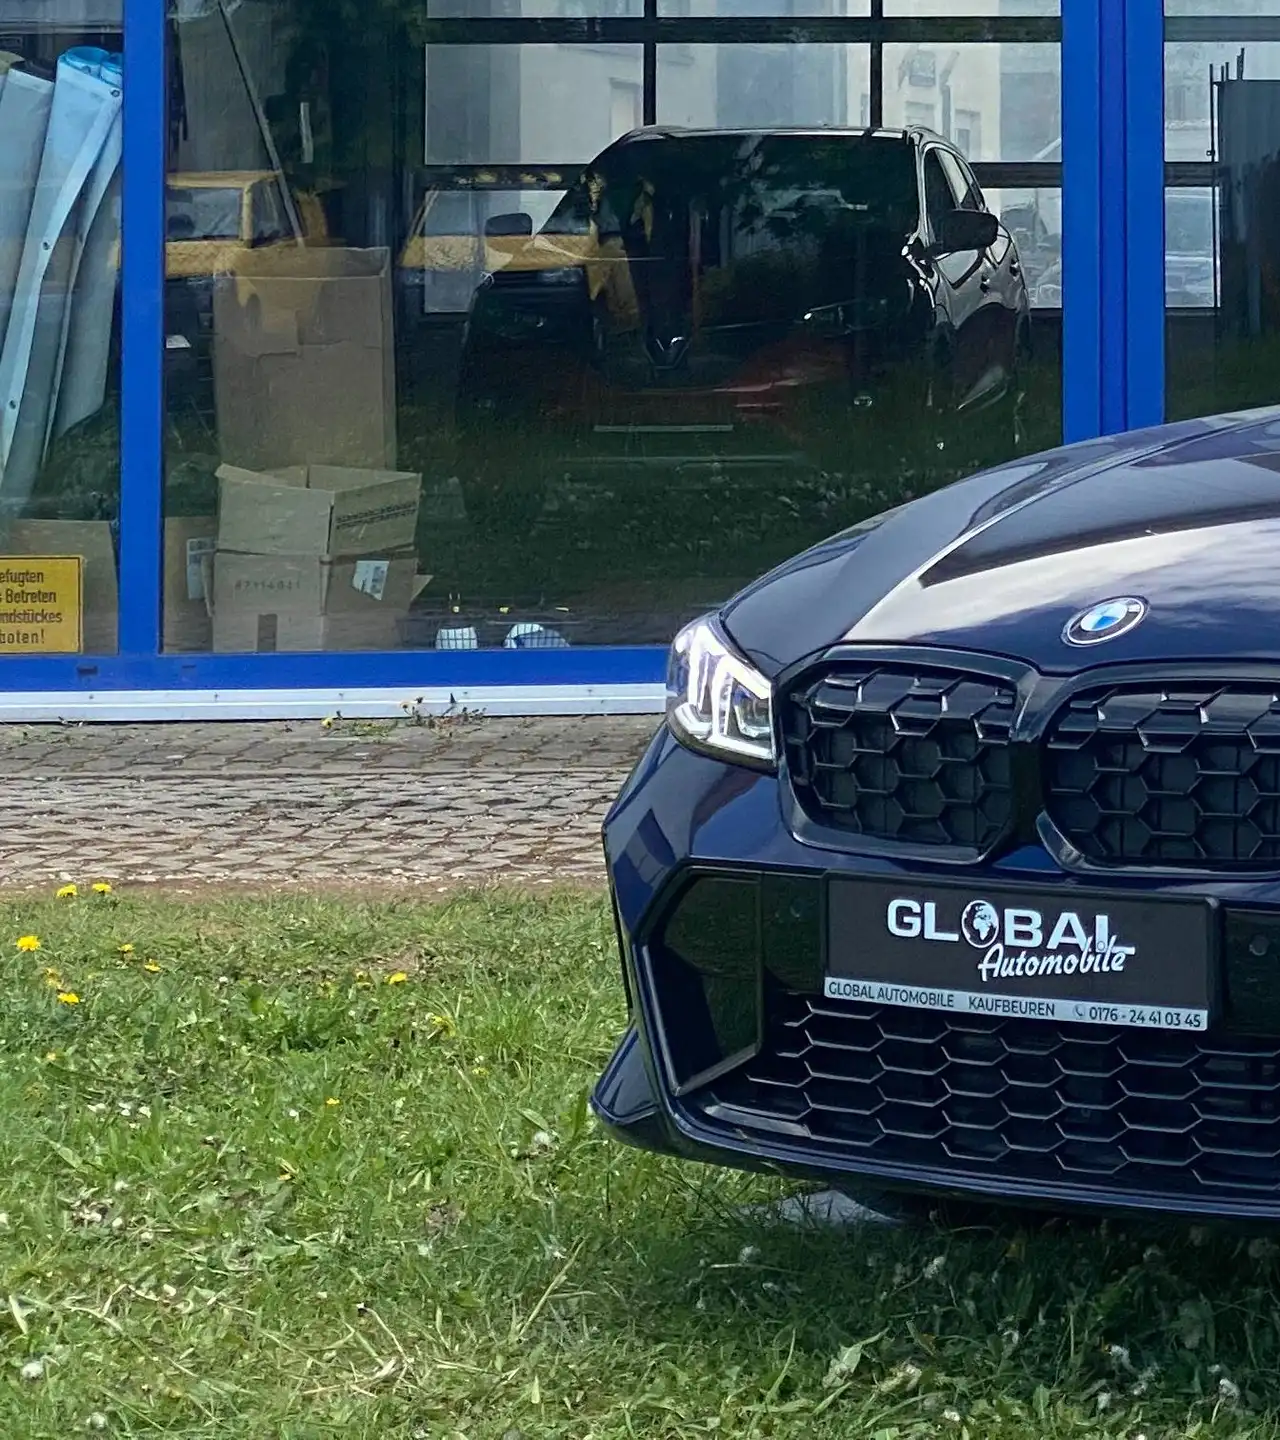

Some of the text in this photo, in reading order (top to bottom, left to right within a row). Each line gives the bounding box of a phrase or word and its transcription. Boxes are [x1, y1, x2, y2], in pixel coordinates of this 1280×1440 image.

[6, 588, 57, 603] Betreten
[887, 899, 1136, 956] GLOBAL
[977, 934, 1127, 982] Automobile
[828, 981, 875, 1000] GLOBAL
[877, 987, 954, 1008] AUTOMOBILE
[968, 995, 1055, 1016] KAUFBEUREN
[1088, 1006, 1118, 1022] 0176
[1129, 1009, 1145, 1024] 24
[1148, 1011, 1161, 1025] 41
[1165, 1011, 1181, 1027] 03
[1184, 1013, 1201, 1028] 45
